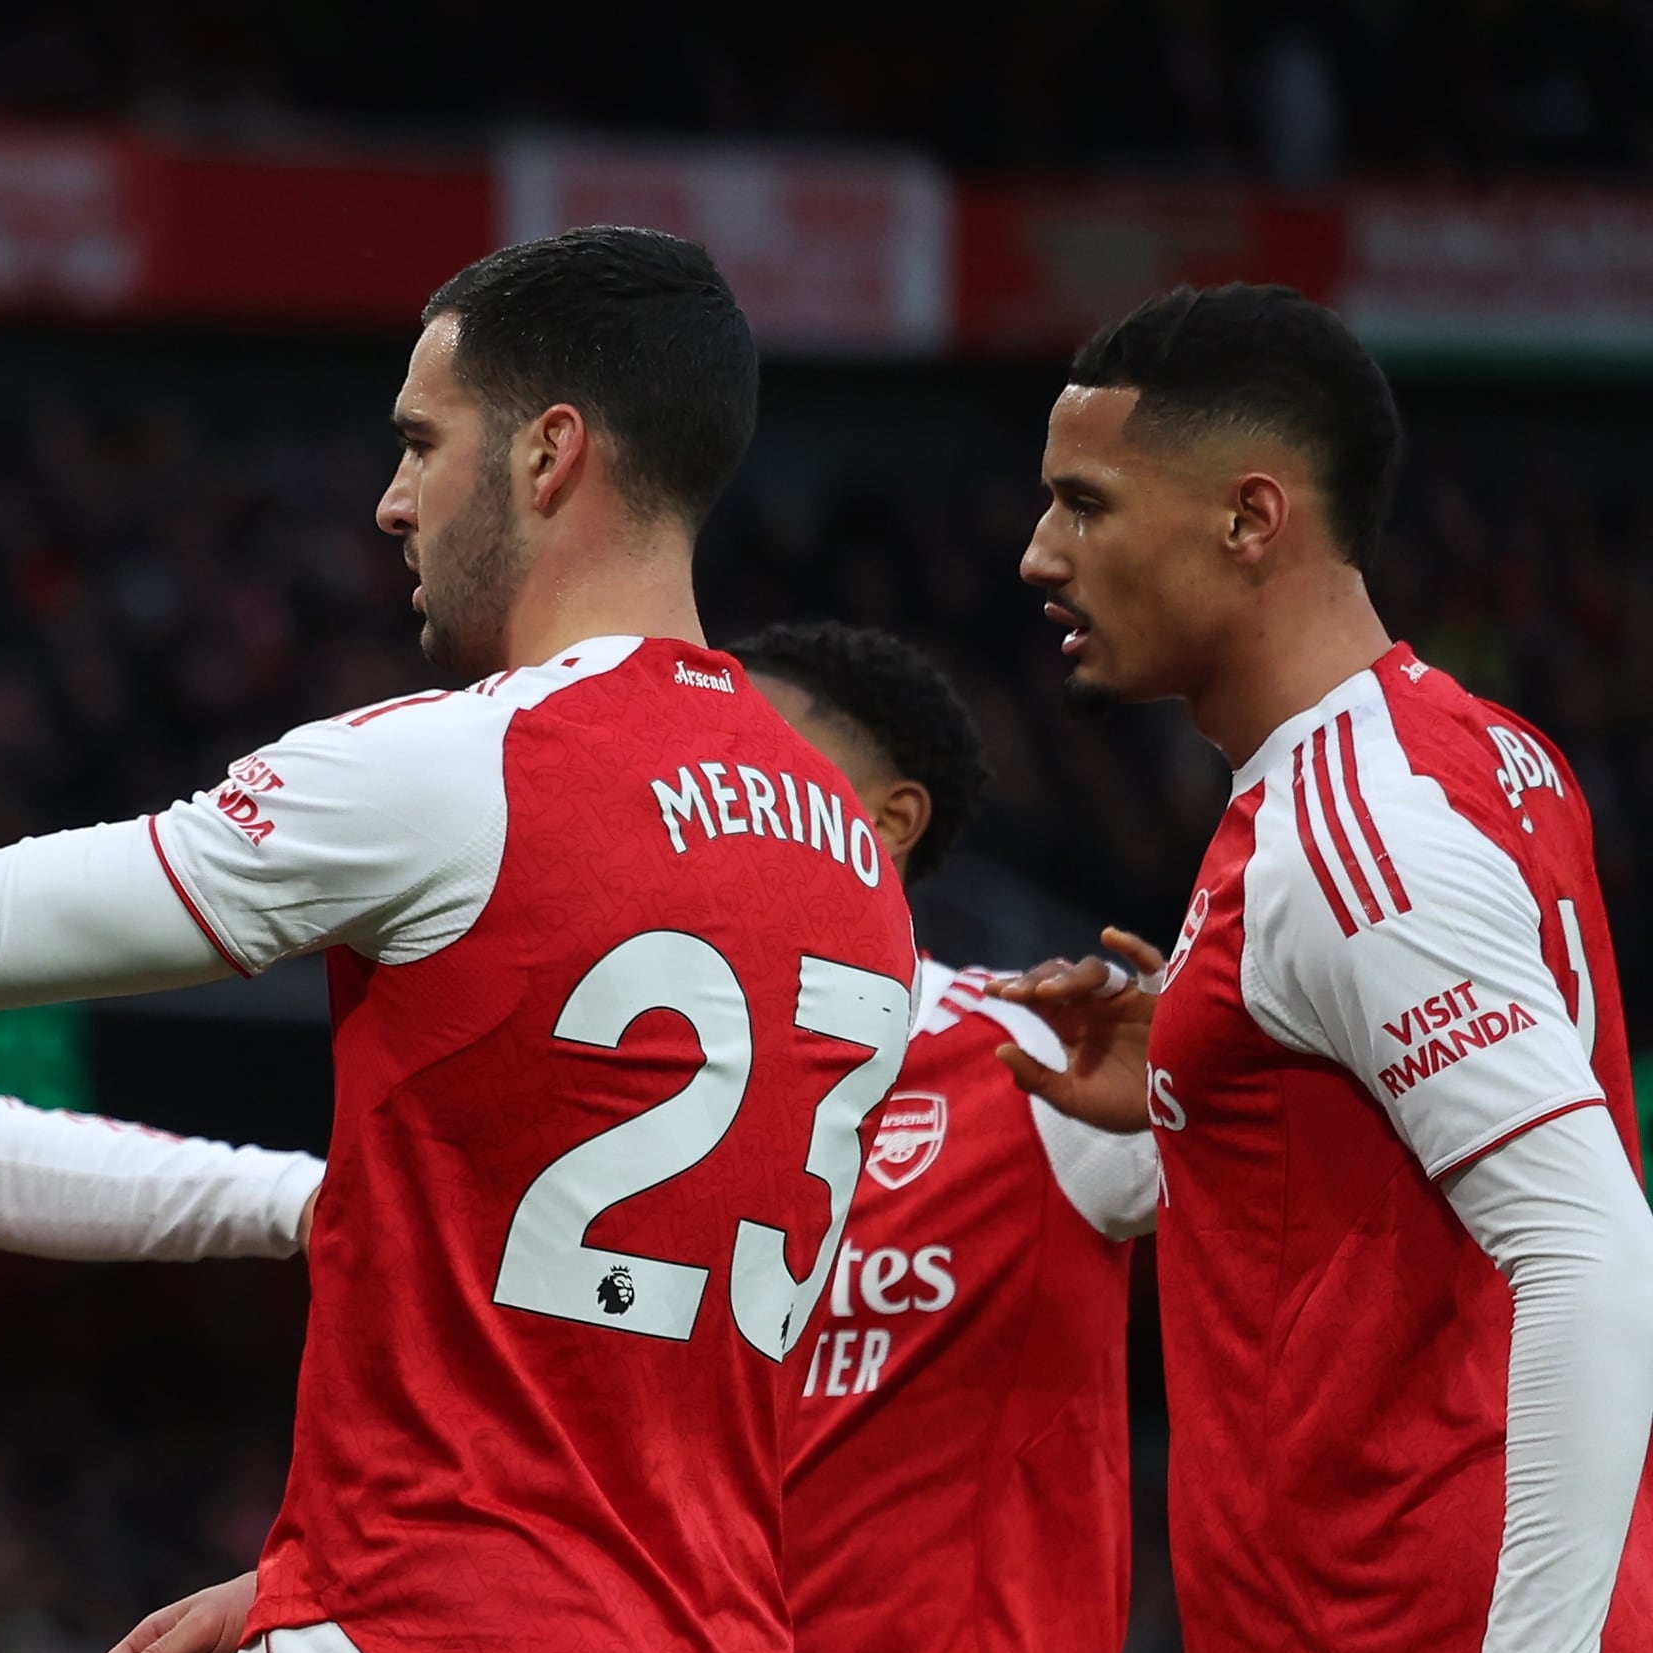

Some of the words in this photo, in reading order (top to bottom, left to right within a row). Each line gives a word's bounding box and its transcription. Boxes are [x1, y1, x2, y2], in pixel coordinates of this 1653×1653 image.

[674, 660, 735, 694] Arsenal
[650, 761, 880, 888] MERINO
[1377, 1002, 1539, 1100] RWANDA
[1381, 979, 1479, 1047] VISIT
[492, 929, 911, 1364] 23
